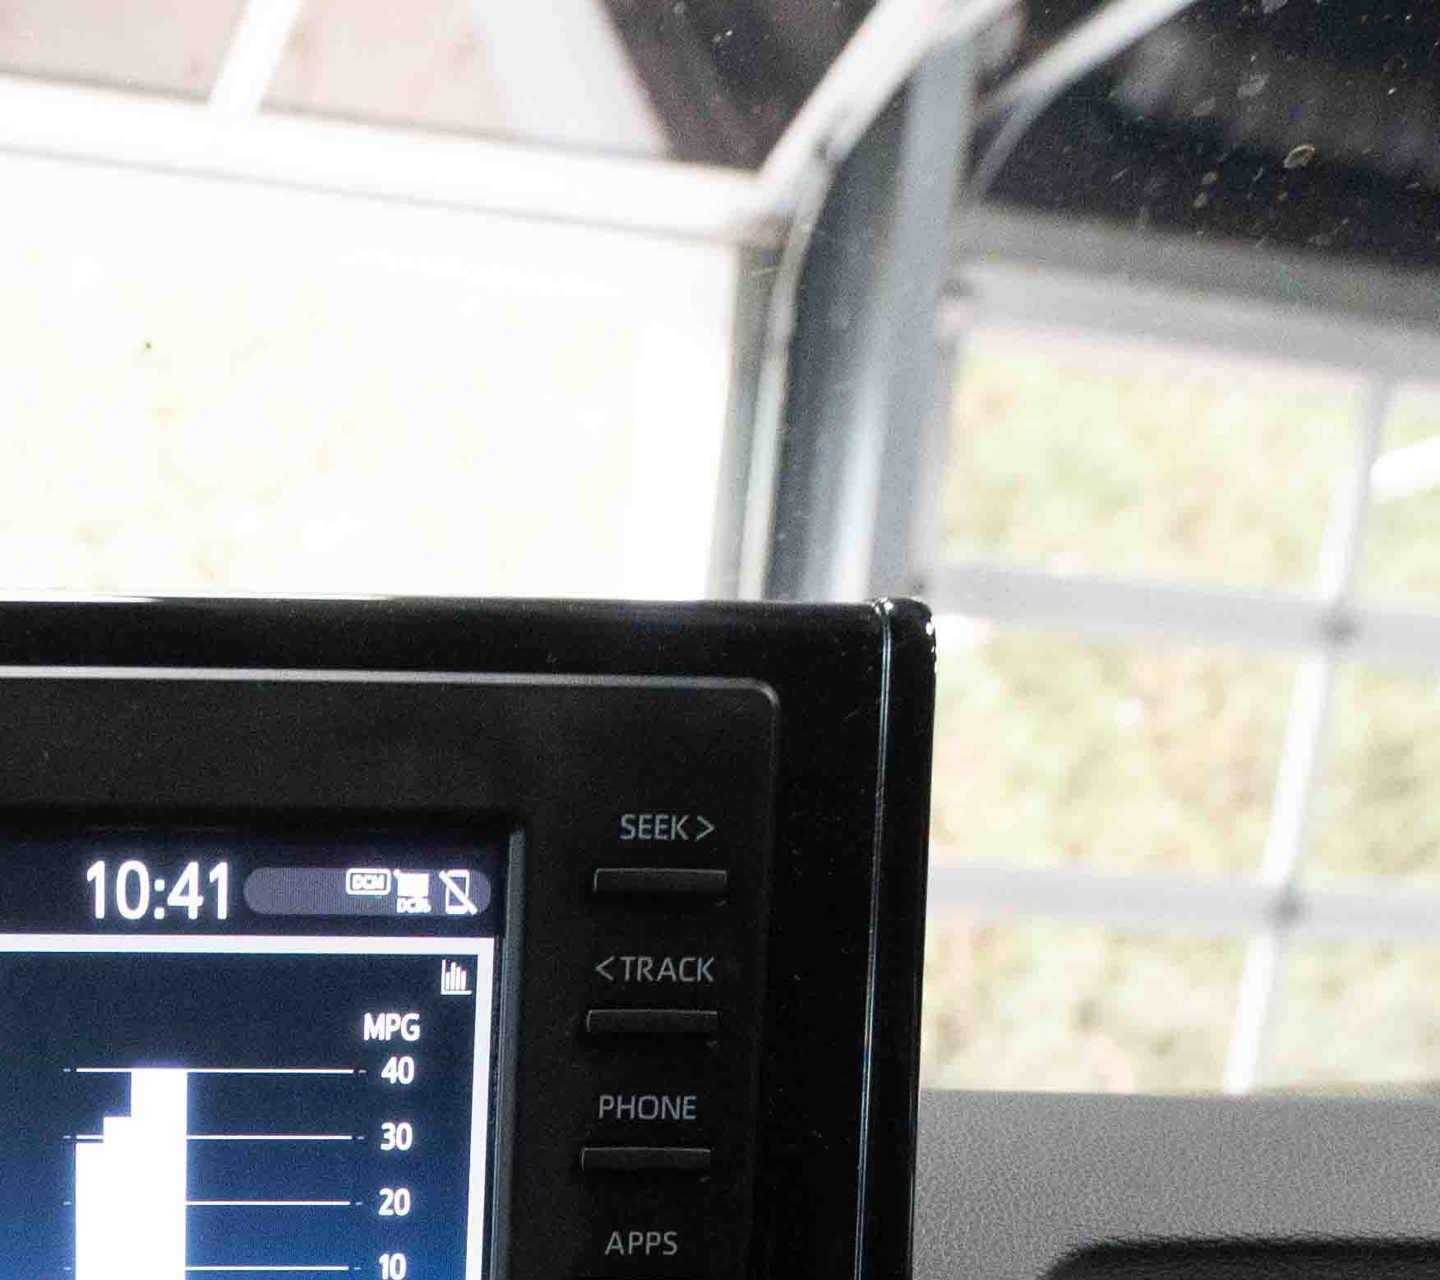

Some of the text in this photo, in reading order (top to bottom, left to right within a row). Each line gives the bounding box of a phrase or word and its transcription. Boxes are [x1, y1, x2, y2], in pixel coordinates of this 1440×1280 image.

[86, 860, 231, 920] 10:41
[363, 1012, 421, 1042] MPG
[381, 1056, 416, 1085] 40
[598, 1095, 697, 1121] PHONE
[380, 1123, 414, 1152] 30
[378, 1188, 411, 1216] 20
[605, 1231, 679, 1257] APPS
[378, 1253, 408, 1280] 10
